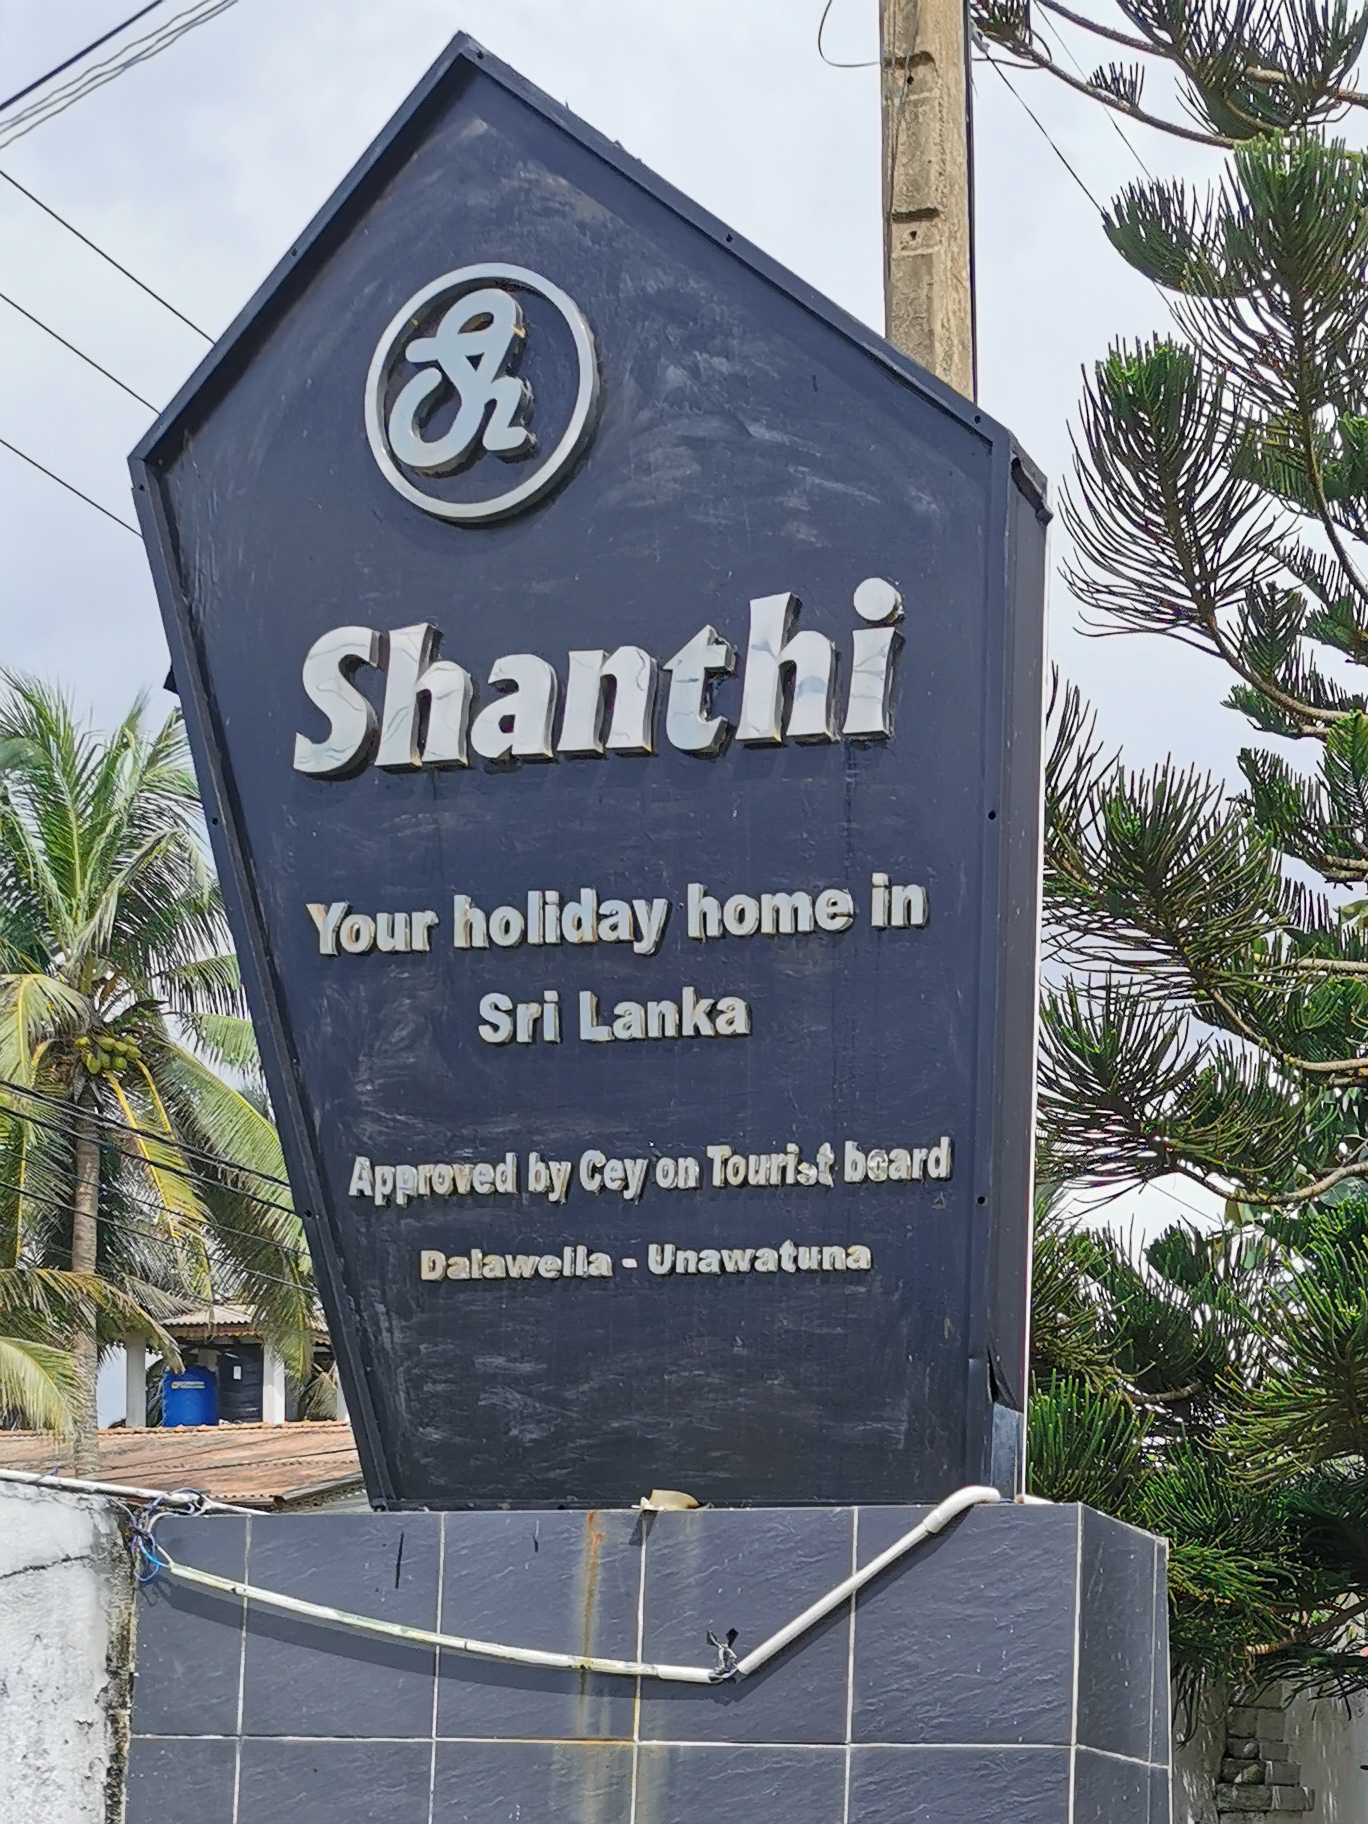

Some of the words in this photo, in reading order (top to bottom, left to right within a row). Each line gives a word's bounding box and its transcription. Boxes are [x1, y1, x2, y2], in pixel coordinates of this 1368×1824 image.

[293, 577, 905, 782] Shanthi
[306, 900, 439, 956] Your
[453, 887, 669, 956] holiday
[687, 882, 854, 942] home
[871, 872, 930, 929] in
[478, 990, 562, 1045] Sri
[578, 986, 752, 1042] Lanka
[348, 1152, 520, 1207] Approved
[527, 1152, 572, 1204] by
[706, 1141, 836, 1189] Tourist
[844, 1135, 955, 1184] board
[419, 1245, 615, 1283] Dalawella
[647, 1240, 874, 1277] Unawatuna
